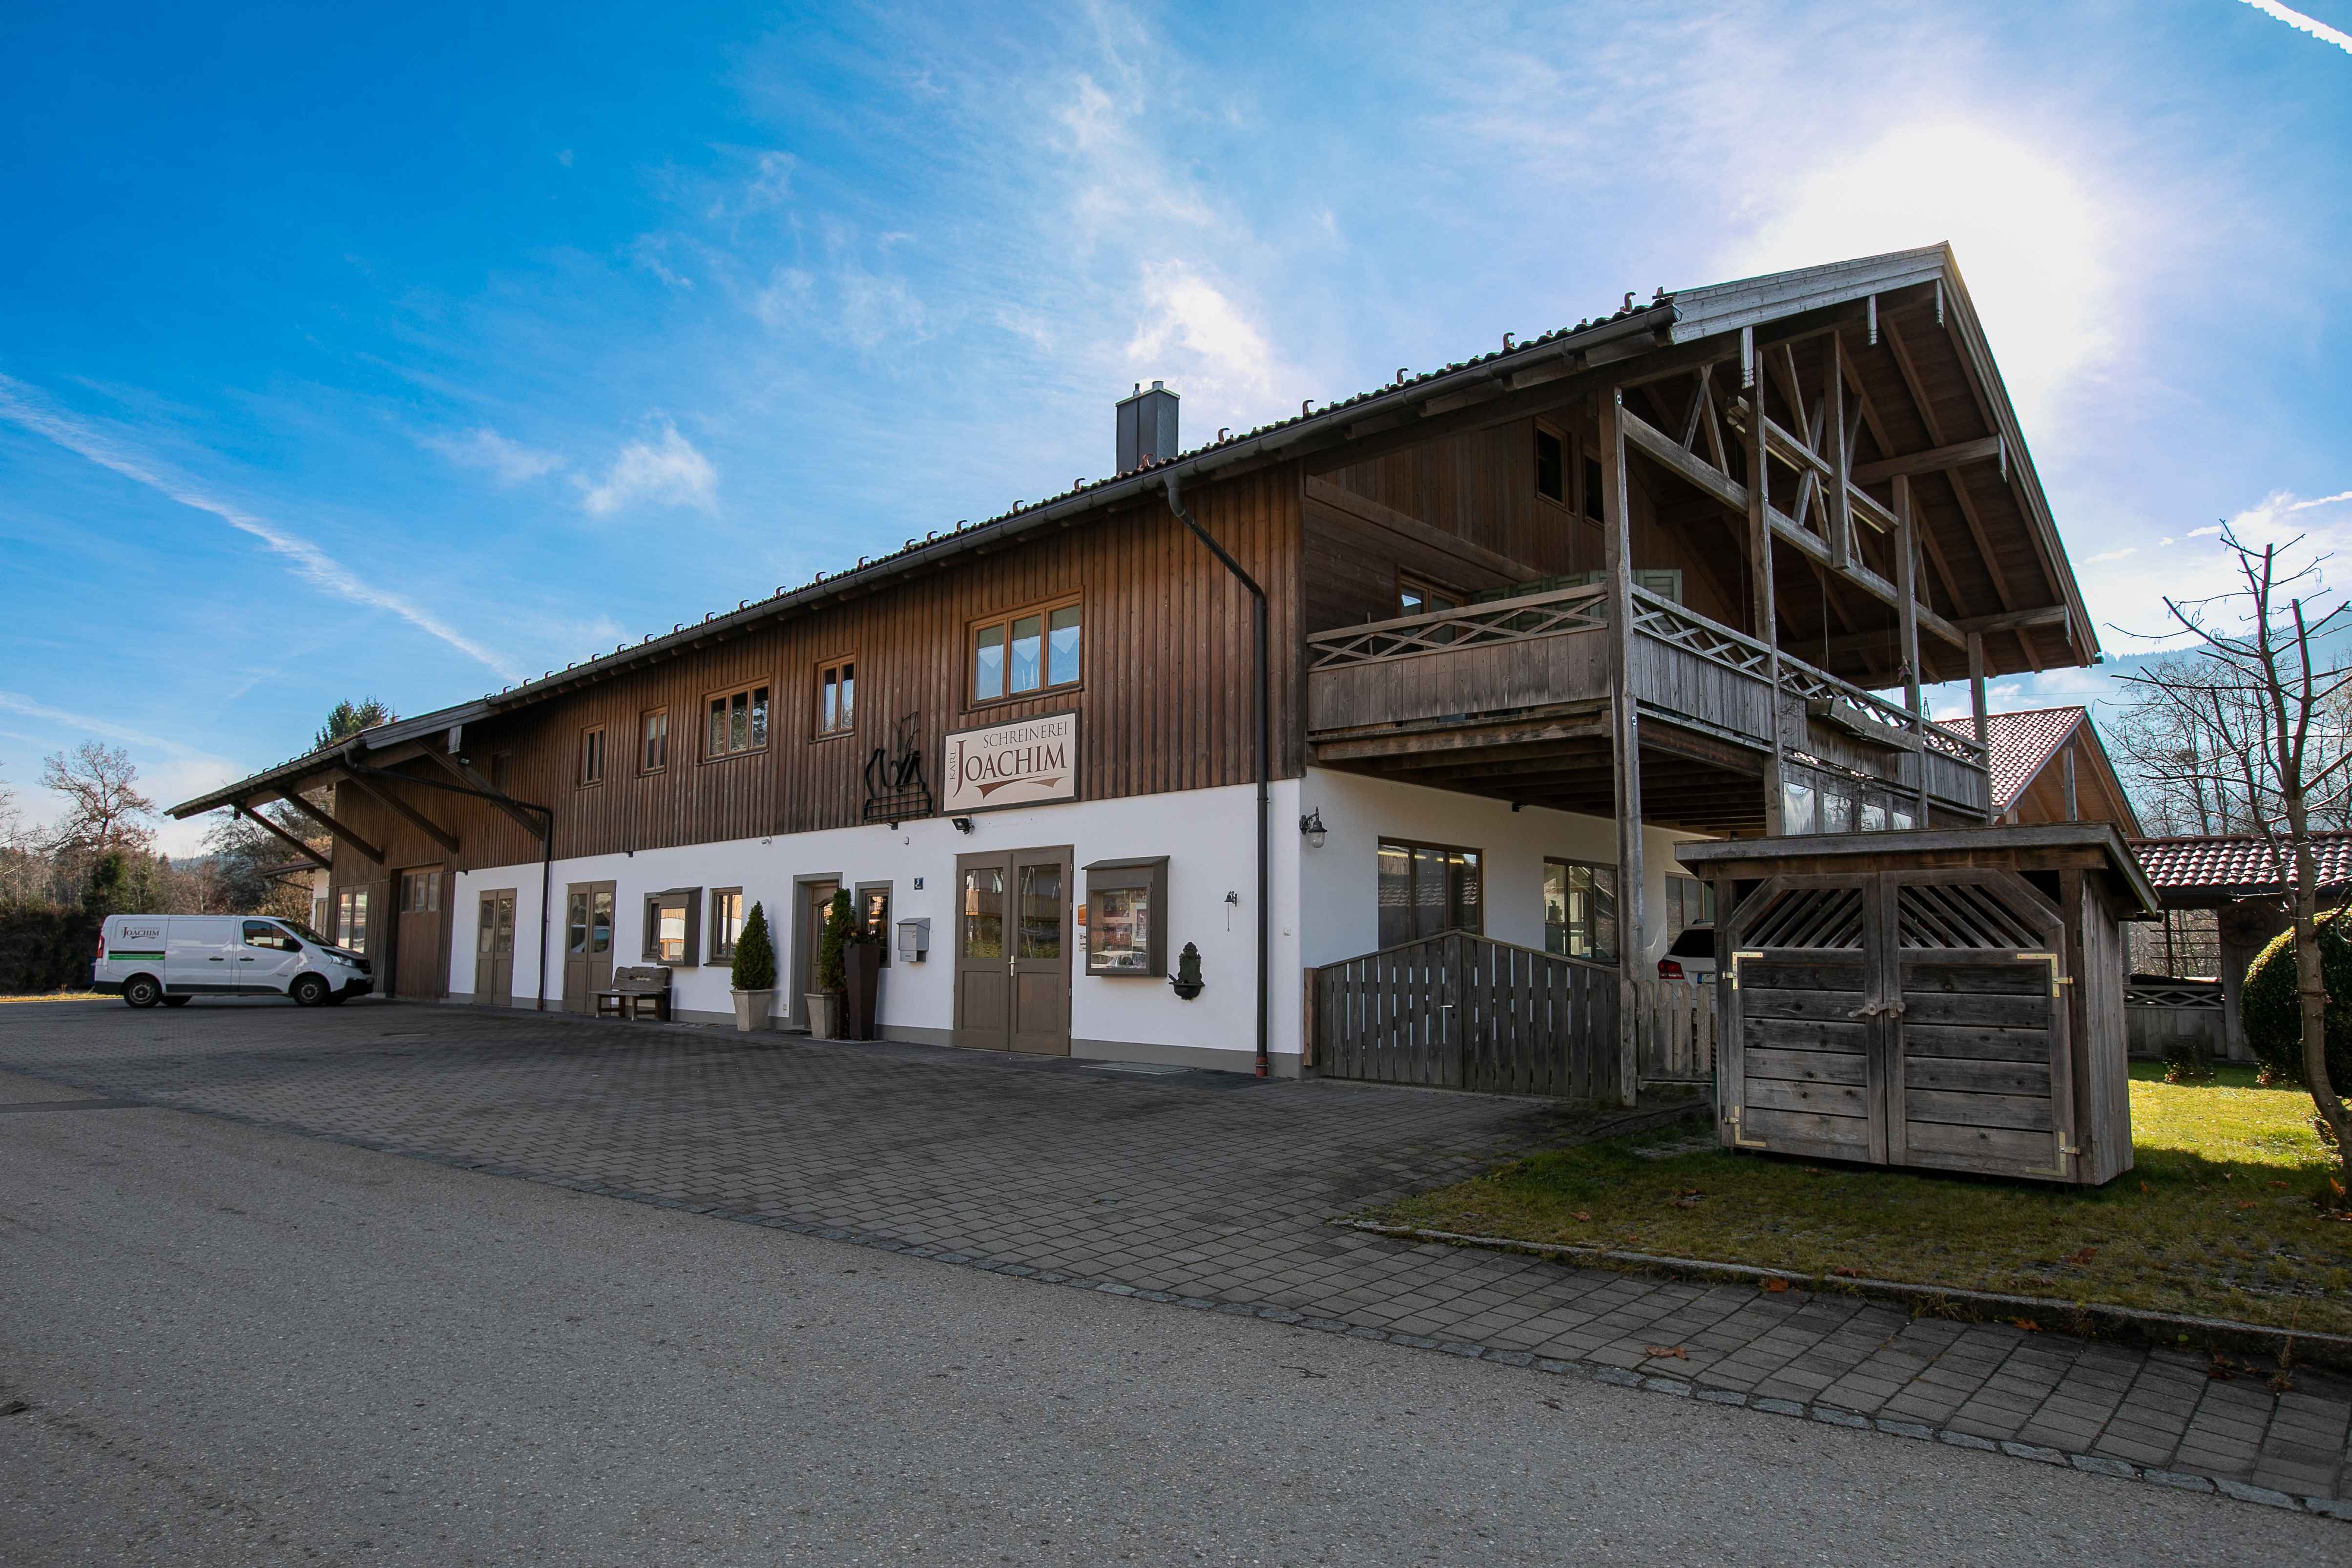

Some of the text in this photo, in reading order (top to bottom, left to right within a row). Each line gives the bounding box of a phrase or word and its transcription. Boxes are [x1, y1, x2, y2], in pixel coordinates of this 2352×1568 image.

[983, 721, 1068, 748] SCHREINEREI
[953, 740, 1068, 797] JOACHIM
[122, 926, 160, 938] JOACHIM
